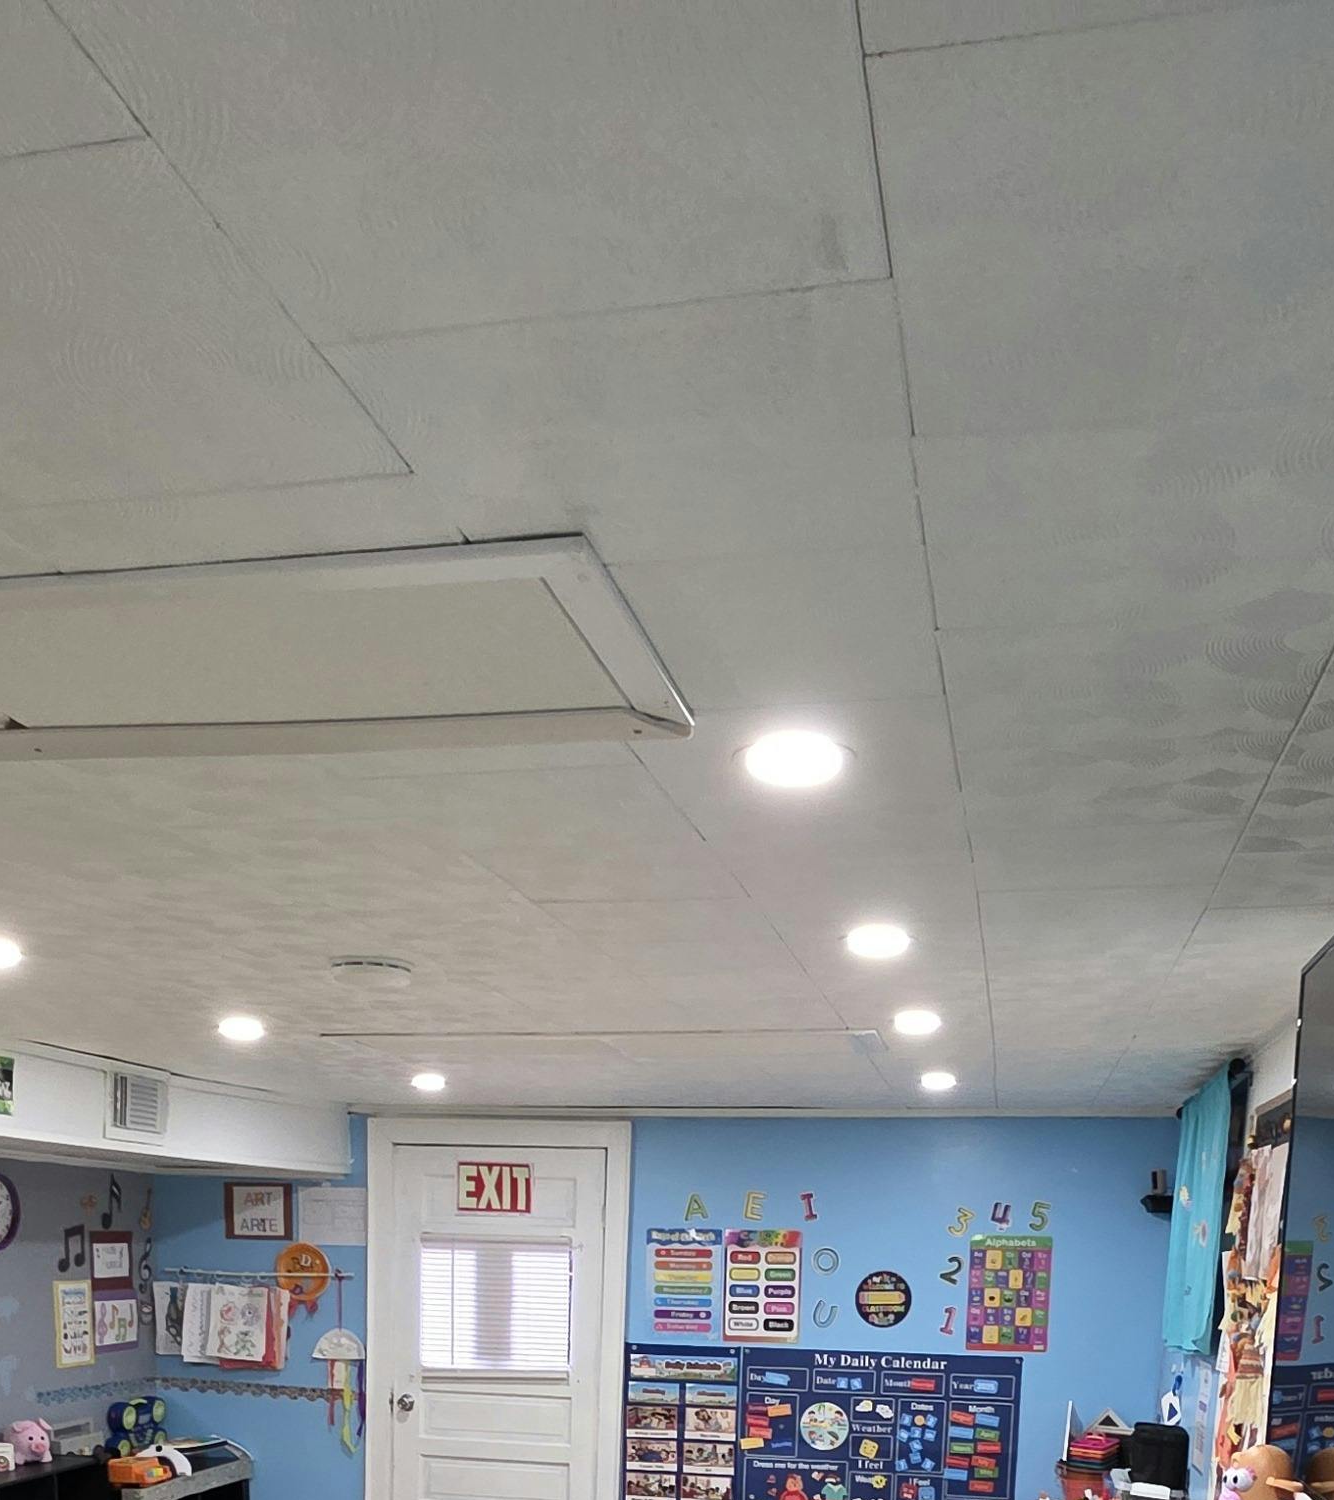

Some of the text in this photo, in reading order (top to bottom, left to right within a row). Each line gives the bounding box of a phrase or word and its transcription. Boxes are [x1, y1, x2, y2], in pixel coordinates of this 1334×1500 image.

[457, 1163, 530, 1212] EXIT
[685, 1193, 708, 1221] A
[745, 1192, 767, 1220] E
[800, 1193, 818, 1221] I
[991, 1202, 1011, 1231] 4
[1029, 1202, 1051, 1231] 5
[948, 1208, 975, 1235] 3
[985, 1237, 1038, 1248] Alphabets
[939, 1256, 962, 1285] 2
[813, 1299, 838, 1327] U
[940, 1307, 956, 1334] 1
[814, 1354, 947, 1371] My Daily Calendar
[816, 1376, 836, 1386] Date
[953, 1381, 974, 1390] Year
[764, 1396, 781, 1406] Day
[910, 1402, 934, 1411] Dates
[968, 1405, 995, 1413] Month
[851, 1424, 893, 1435] Weather
[811, 1463, 838, 1471] weather
[865, 1460, 883, 1470] feel
